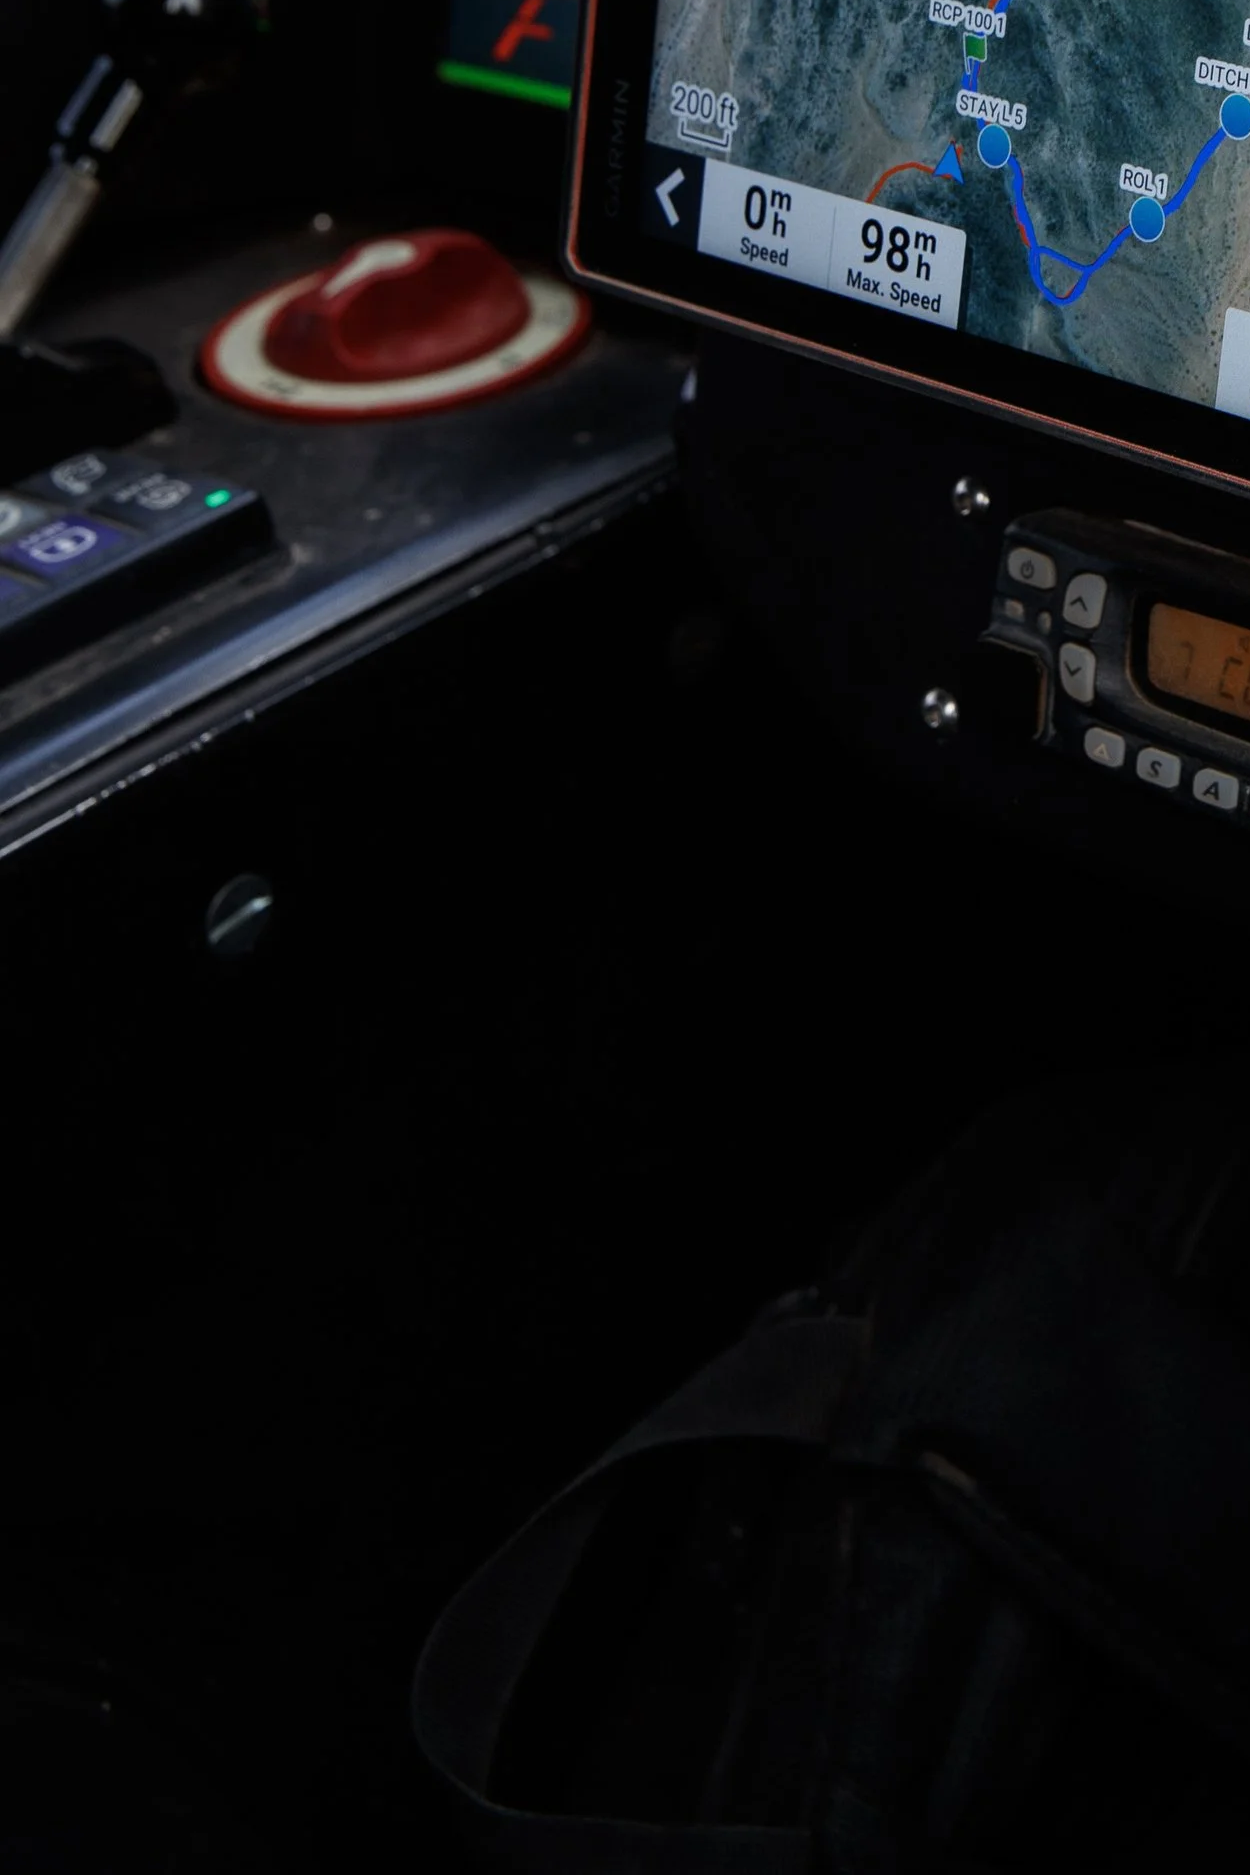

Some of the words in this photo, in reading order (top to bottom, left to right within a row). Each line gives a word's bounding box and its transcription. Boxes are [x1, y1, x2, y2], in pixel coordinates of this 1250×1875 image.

[932, 1, 963, 22] RCP
[967, 9, 993, 31] 100
[996, 16, 1004, 34] 1
[1198, 62, 1249, 89] DITCH
[672, 86, 713, 119] 200
[719, 97, 737, 127] ft
[960, 94, 999, 119] STAY
[1002, 104, 1010, 122] L
[1014, 108, 1024, 126] 5
[603, 78, 632, 219] GARMIN
[1122, 168, 1153, 193] ROL
[1157, 178, 1165, 195] 1
[743, 185, 768, 231] 0
[740, 237, 789, 267] Speed
[861, 218, 911, 274] 98
[847, 268, 885, 296] Max.
[889, 282, 942, 314] Speed
[1145, 760, 1163, 779] S
[1202, 781, 1221, 801] A
